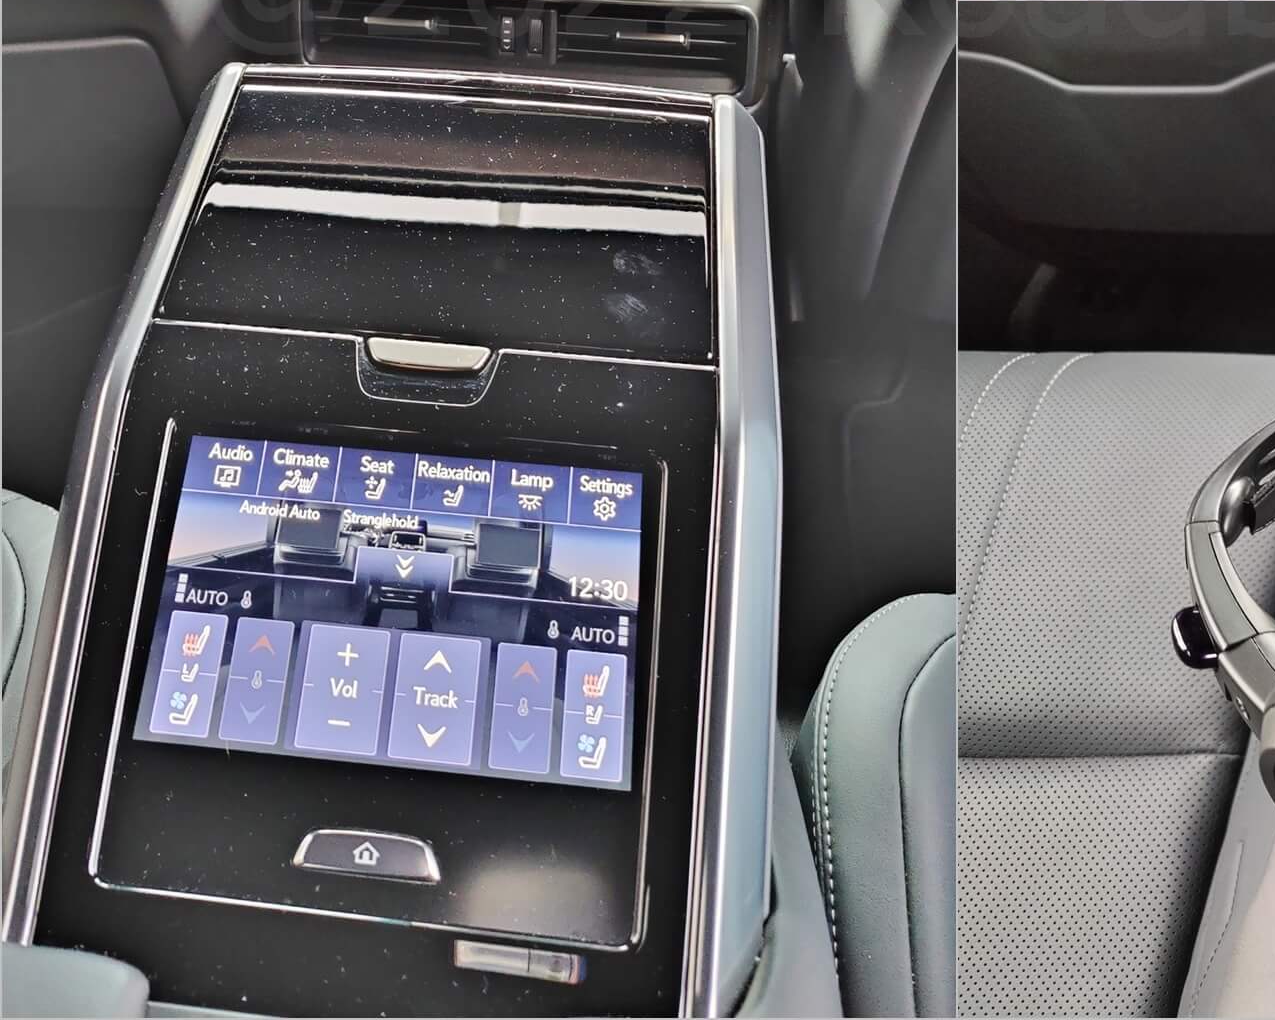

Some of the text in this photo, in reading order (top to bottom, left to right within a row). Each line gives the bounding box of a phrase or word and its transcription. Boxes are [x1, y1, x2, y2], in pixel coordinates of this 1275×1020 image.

[208, 442, 254, 463] Audio
[273, 448, 330, 469] Climate
[360, 456, 395, 475] Seat
[418, 460, 490, 484] Relaxation
[511, 468, 554, 492] Lamp
[580, 475, 634, 499] Settings
[239, 500, 321, 522] Android Auto
[343, 509, 420, 530] Stranglehold
[185, 590, 229, 607] AUTO
[566, 576, 629, 602] 12:30
[570, 626, 616, 645] AUTO
[330, 676, 359, 700] Vol
[412, 686, 459, 710] Track
